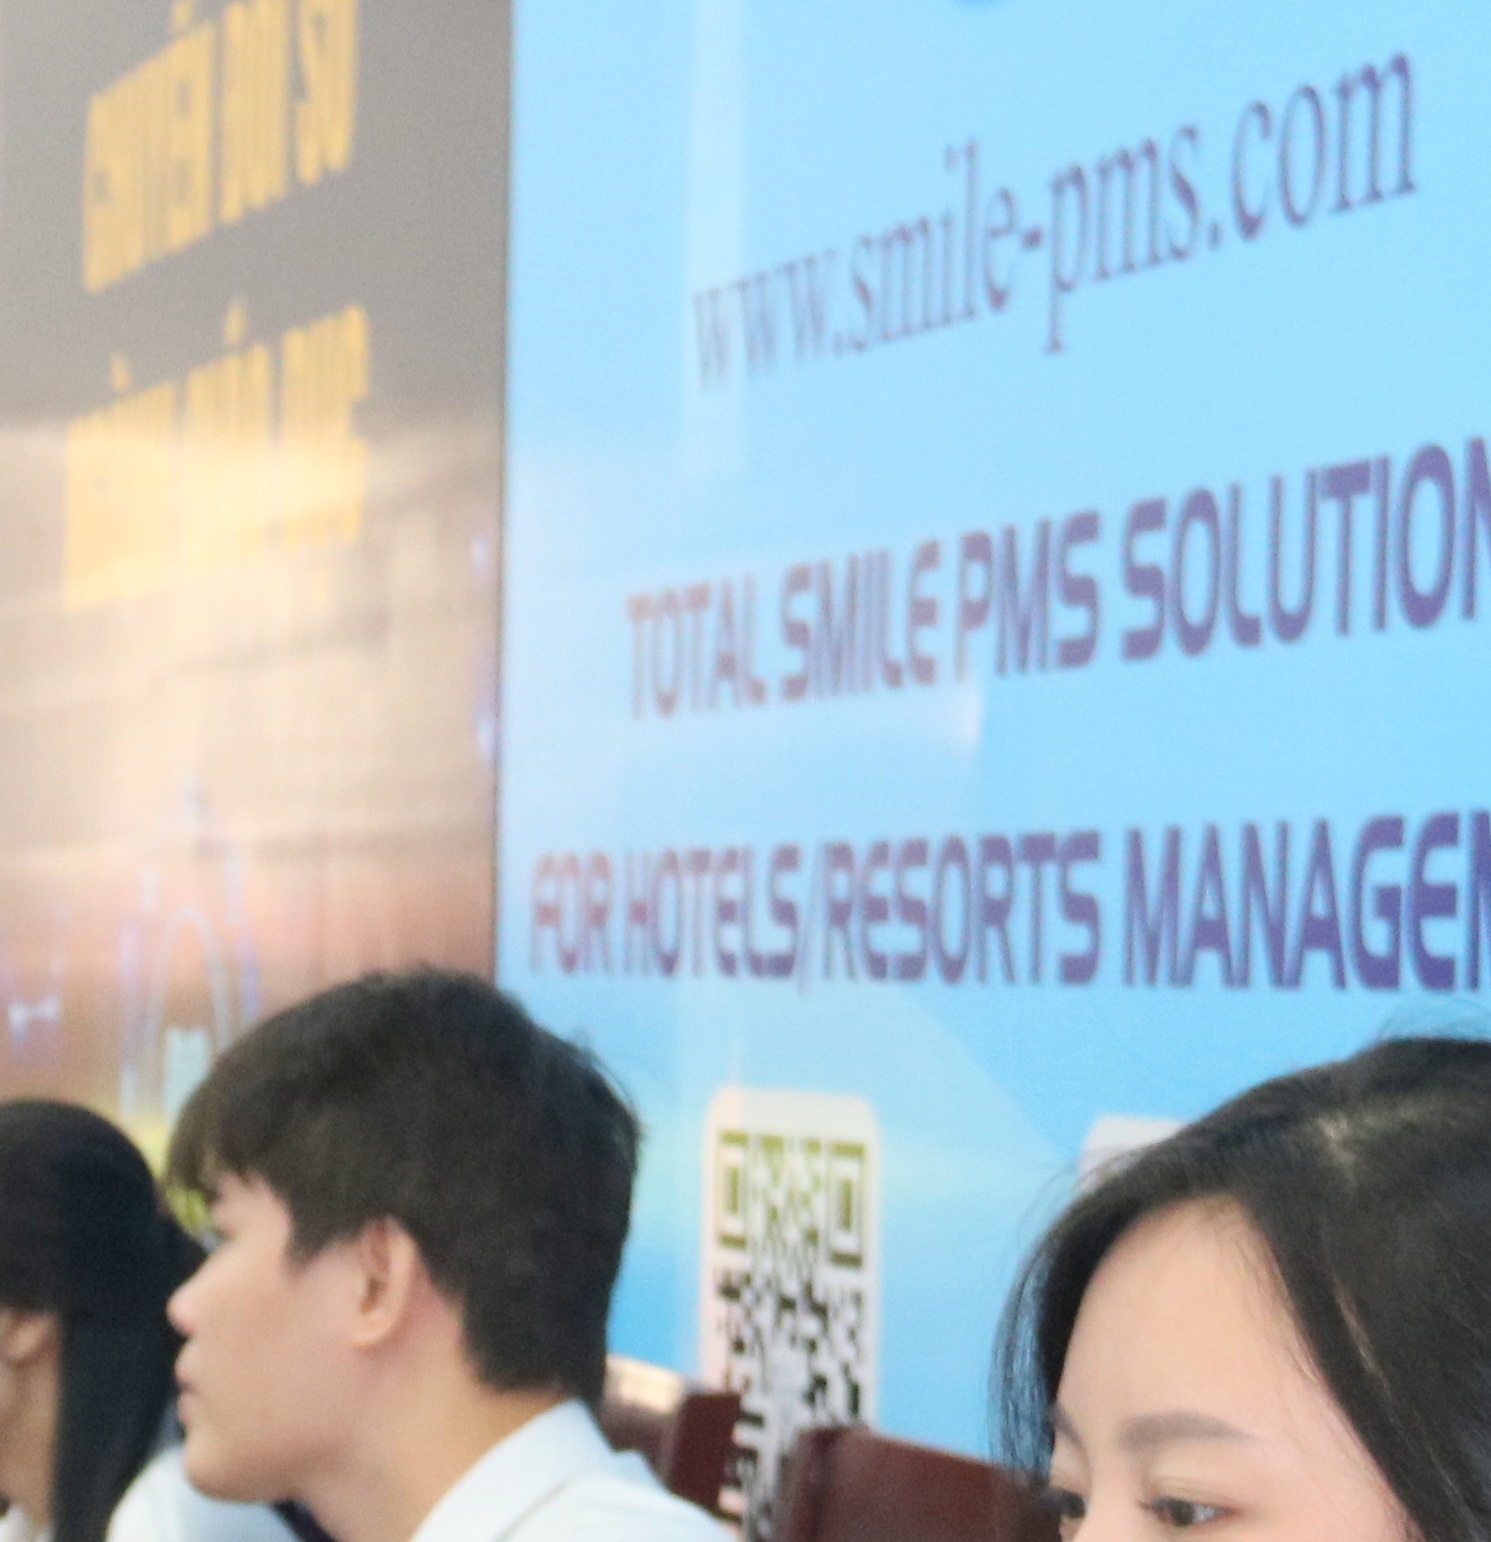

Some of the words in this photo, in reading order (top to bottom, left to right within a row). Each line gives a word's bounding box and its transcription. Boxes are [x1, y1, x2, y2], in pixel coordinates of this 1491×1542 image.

[692, 50, 1417, 388] www.smile-pms.com
[625, 574, 767, 720] TOTAL
[780, 538, 942, 701] SMILE
[955, 509, 1101, 684] PMS
[529, 851, 611, 976] FOR
[624, 828, 1101, 992] HOTELS/RESORTS
